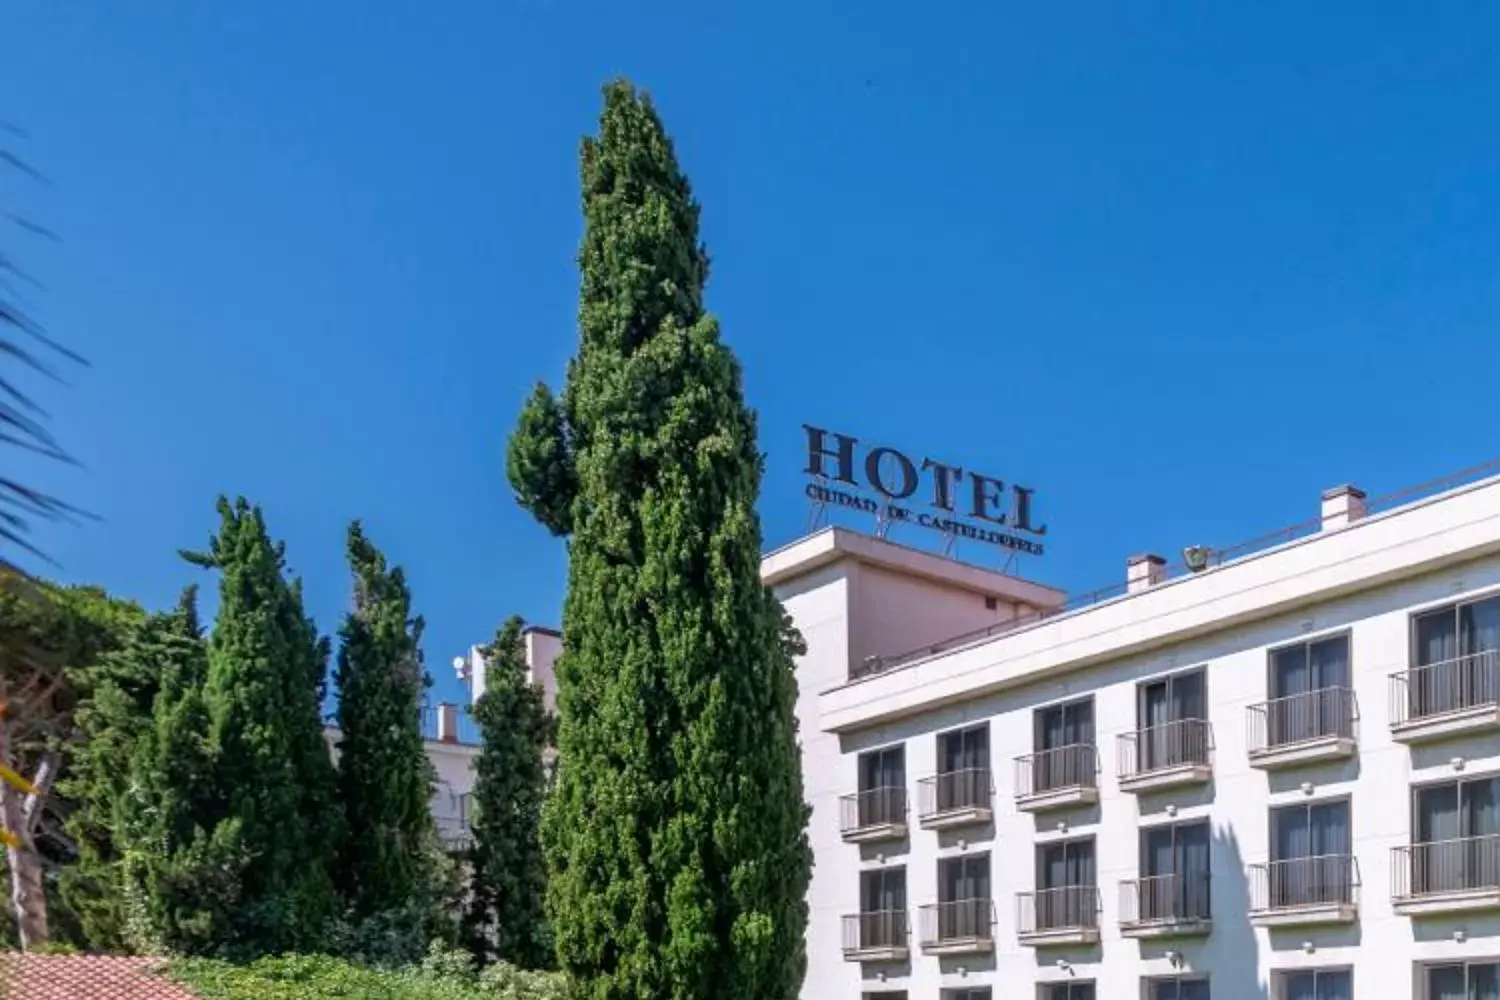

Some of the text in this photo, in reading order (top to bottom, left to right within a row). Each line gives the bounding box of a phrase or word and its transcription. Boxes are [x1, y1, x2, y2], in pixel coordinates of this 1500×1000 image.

[802, 424, 1047, 535] HOTEL
[805, 483, 877, 513] CIUDAD
[887, 505, 912, 521] DE
